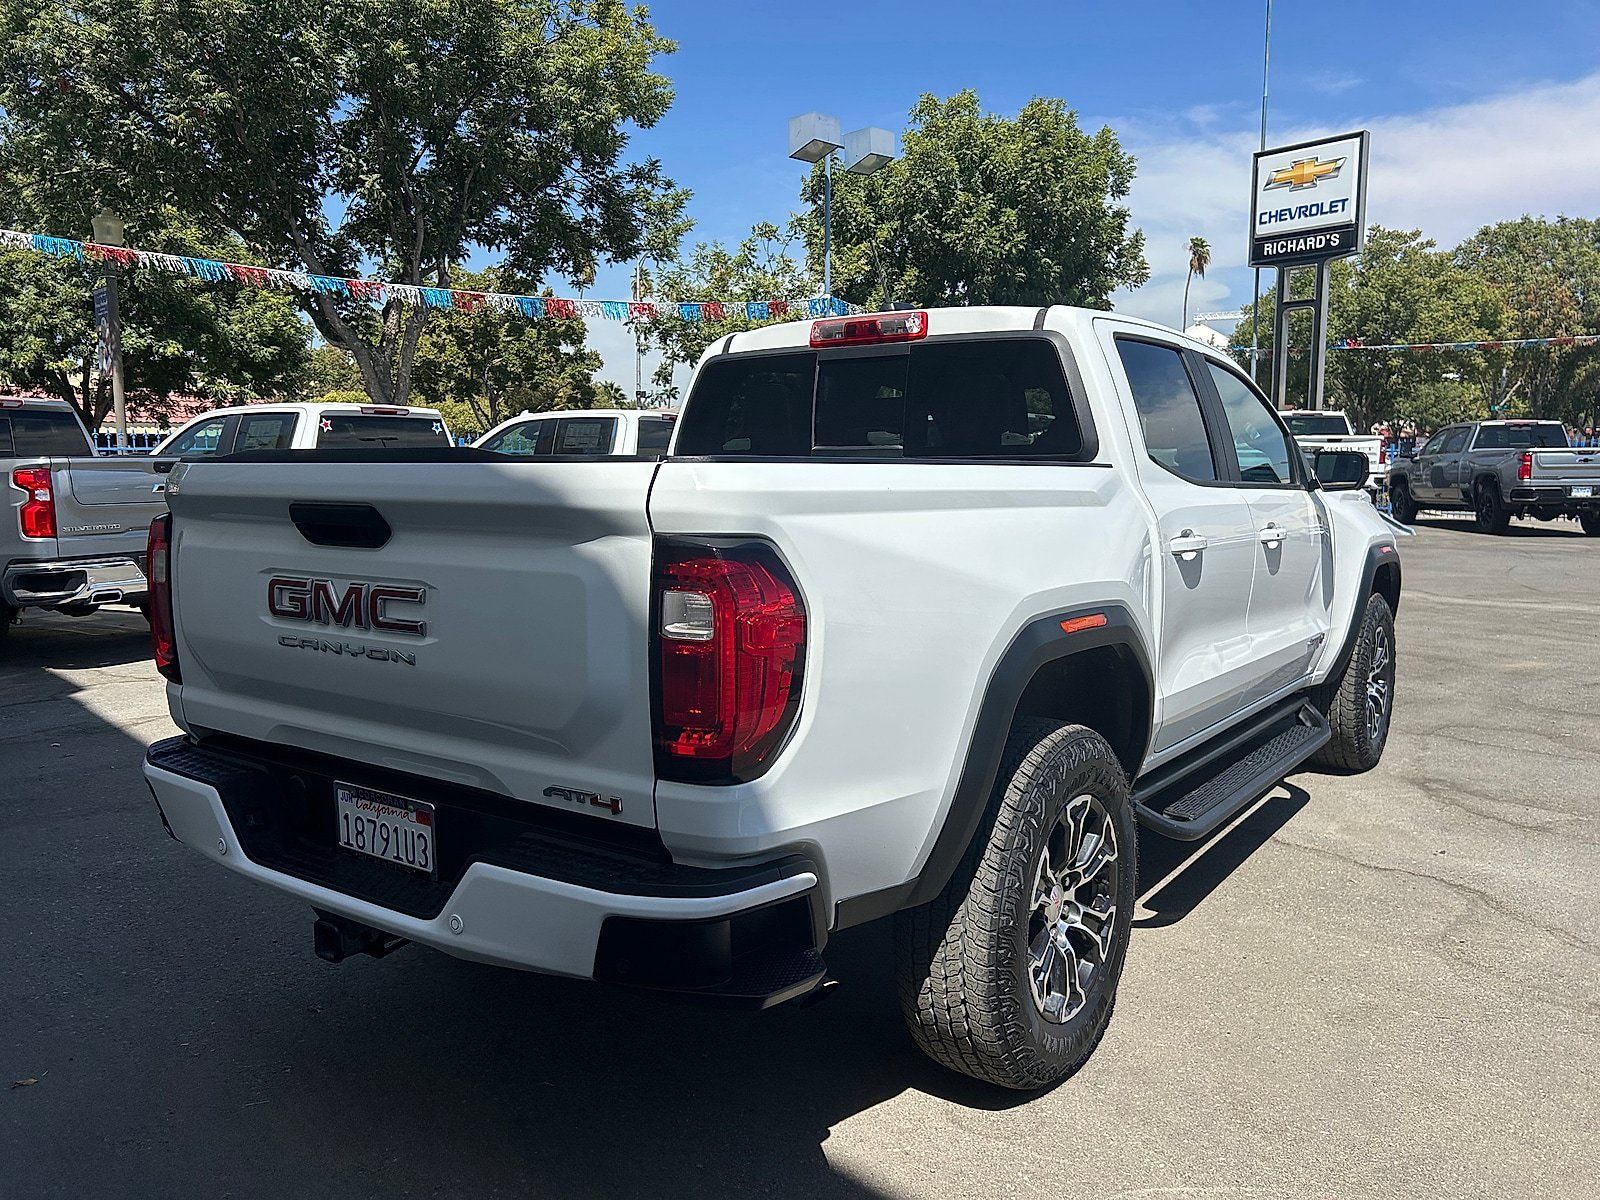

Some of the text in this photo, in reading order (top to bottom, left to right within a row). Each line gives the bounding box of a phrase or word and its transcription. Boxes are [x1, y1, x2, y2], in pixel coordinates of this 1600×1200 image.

[1259, 198, 1349, 225] CHEVROLET
[1263, 234, 1341, 255] RICHARD'S
[62, 523, 121, 532] SILVERADO
[268, 575, 427, 637] GMC
[278, 634, 416, 666] CANYON
[355, 798, 416, 823] California
[542, 784, 623, 815] AT4
[343, 812, 430, 869] 18791U3
